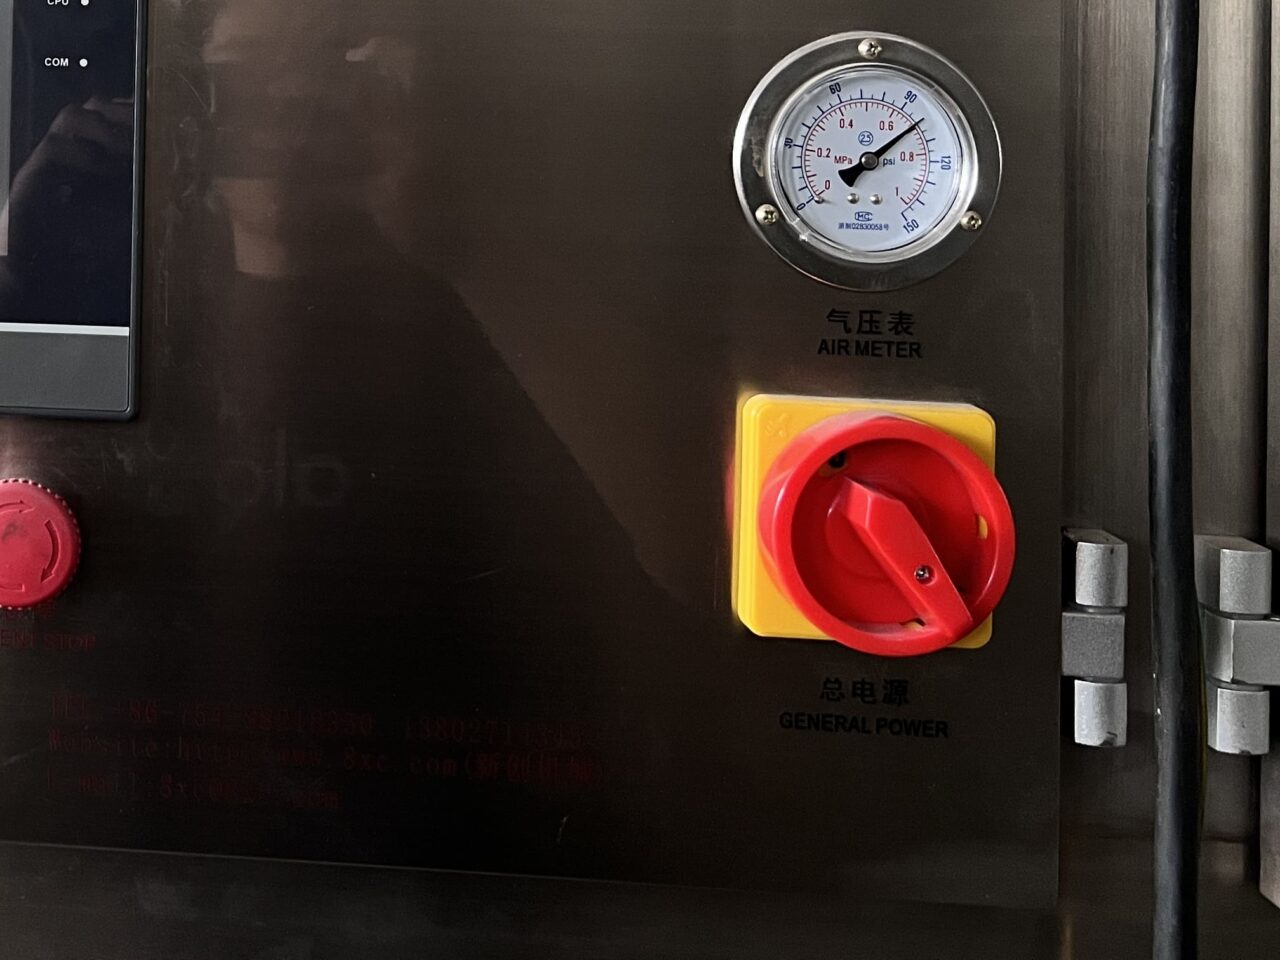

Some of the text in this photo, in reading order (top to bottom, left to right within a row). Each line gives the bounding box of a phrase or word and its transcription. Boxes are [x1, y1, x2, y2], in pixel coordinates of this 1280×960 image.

[44, 57, 69, 67] COM
[828, 82, 842, 95] 60
[904, 90, 918, 104] 90
[839, 118, 854, 129] 0.4
[879, 120, 894, 132] 0.6
[816, 147, 831, 158] 0.2
[899, 151, 915, 162] 0.8
[834, 155, 853, 165] MPa
[882, 156, 896, 167] psi
[940, 155, 952, 171] 120
[824, 179, 831, 191] 0
[796, 202, 806, 212] 0
[902, 218, 920, 234] 150
[826, 309, 915, 336] 气压表
[817, 339, 923, 358] AIR METER
[821, 677, 911, 706] 总电源
[779, 710, 949, 737] GENERAL POWER
